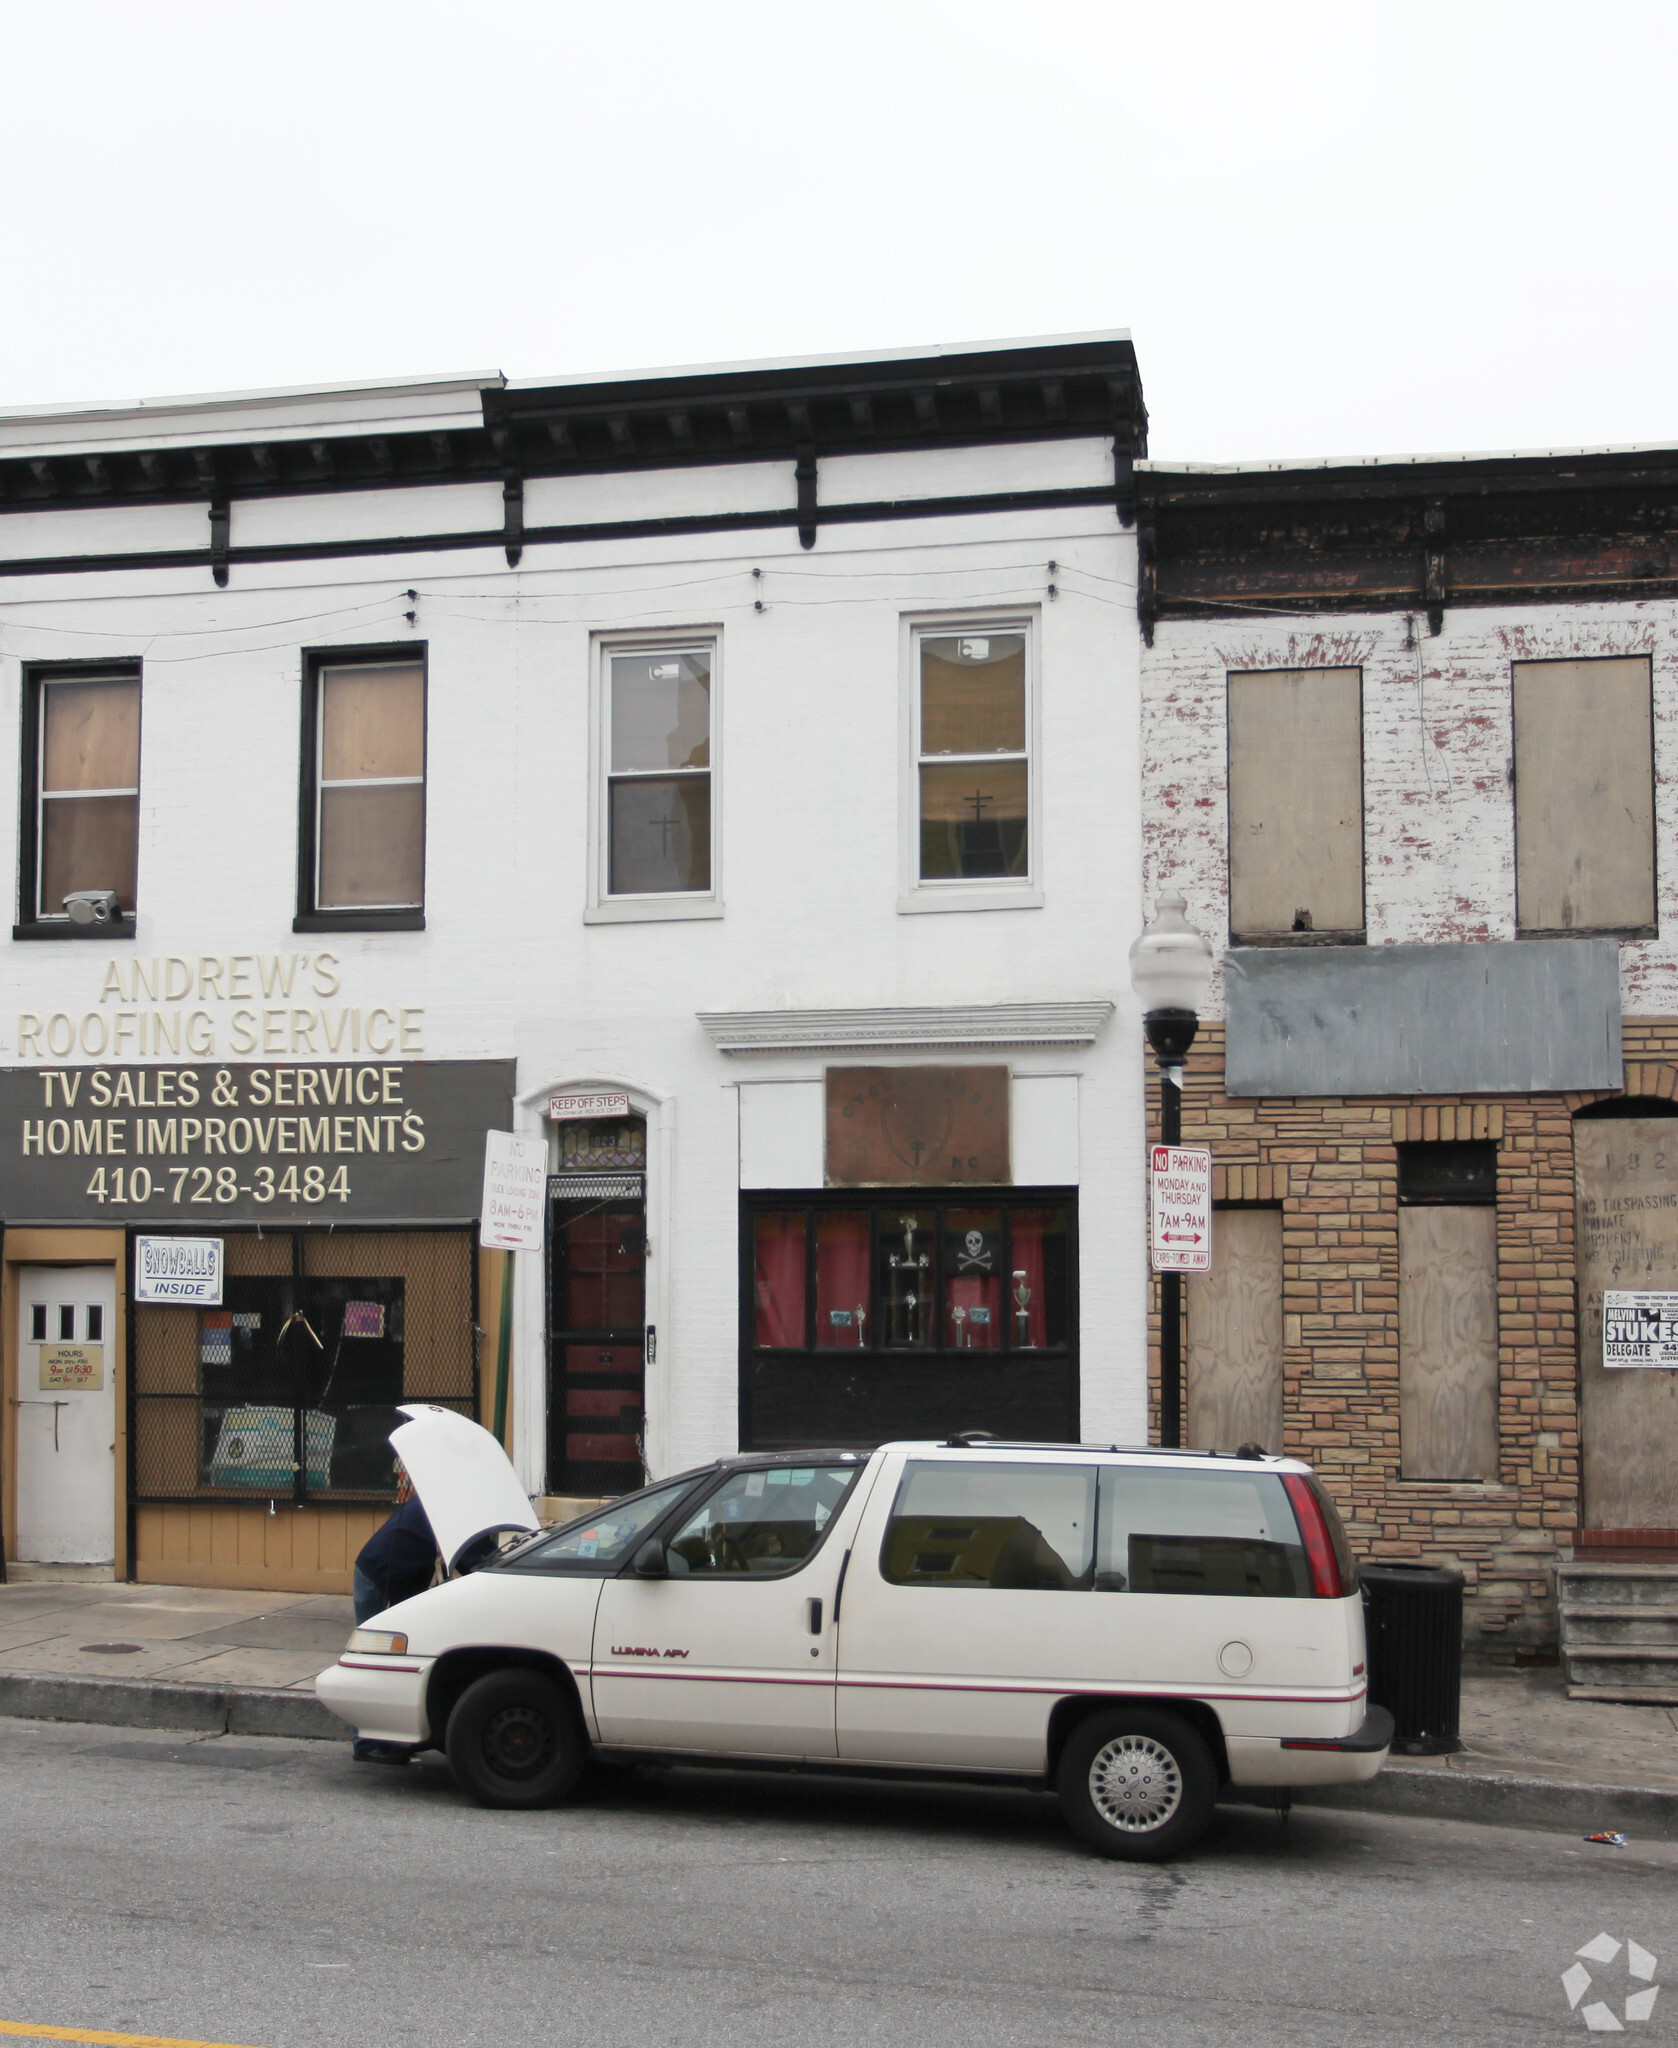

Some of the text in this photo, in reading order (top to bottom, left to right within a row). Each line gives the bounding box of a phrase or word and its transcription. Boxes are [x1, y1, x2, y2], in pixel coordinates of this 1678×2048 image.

[100, 953, 341, 1003] ANDREW'S
[18, 1007, 425, 1058] ROOFING SERVICE
[39, 1067, 404, 1108] TV SALES & SERVICE
[552, 1095, 626, 1110] KEEP OFF STEPS
[23, 1118, 127, 1156] HOME
[590, 1135, 616, 1147] 1823
[509, 1141, 525, 1158] NO
[1155, 1153, 1207, 1173] NO PARKING
[491, 1160, 541, 1184] PARKING
[86, 1165, 352, 1204] 410-728-3484
[507, 1185, 526, 1198] LOADING
[1158, 1178, 1207, 1193] MONDAY AND
[1161, 1191, 1201, 1205] THURSDAY
[1582, 1194, 1677, 1214] NO TRESPASSING
[508, 1223, 521, 1231] THRU
[1158, 1211, 1206, 1229] 7AM-9AM
[1583, 1214, 1626, 1231] PRIVATE
[1584, 1231, 1641, 1247] PROPERTY
[145, 1244, 216, 1276] SNOWBALLS
[1173, 1253, 1190, 1265] TOWED
[1193, 1254, 1207, 1265] AWAY
[154, 1283, 206, 1295] INSIDE
[1607, 1308, 1636, 1321] MELVIN
[1638, 1309, 1647, 1321] L.
[1606, 1344, 1651, 1356] DELEGATE
[611, 1646, 690, 1658] LUMINA APV
